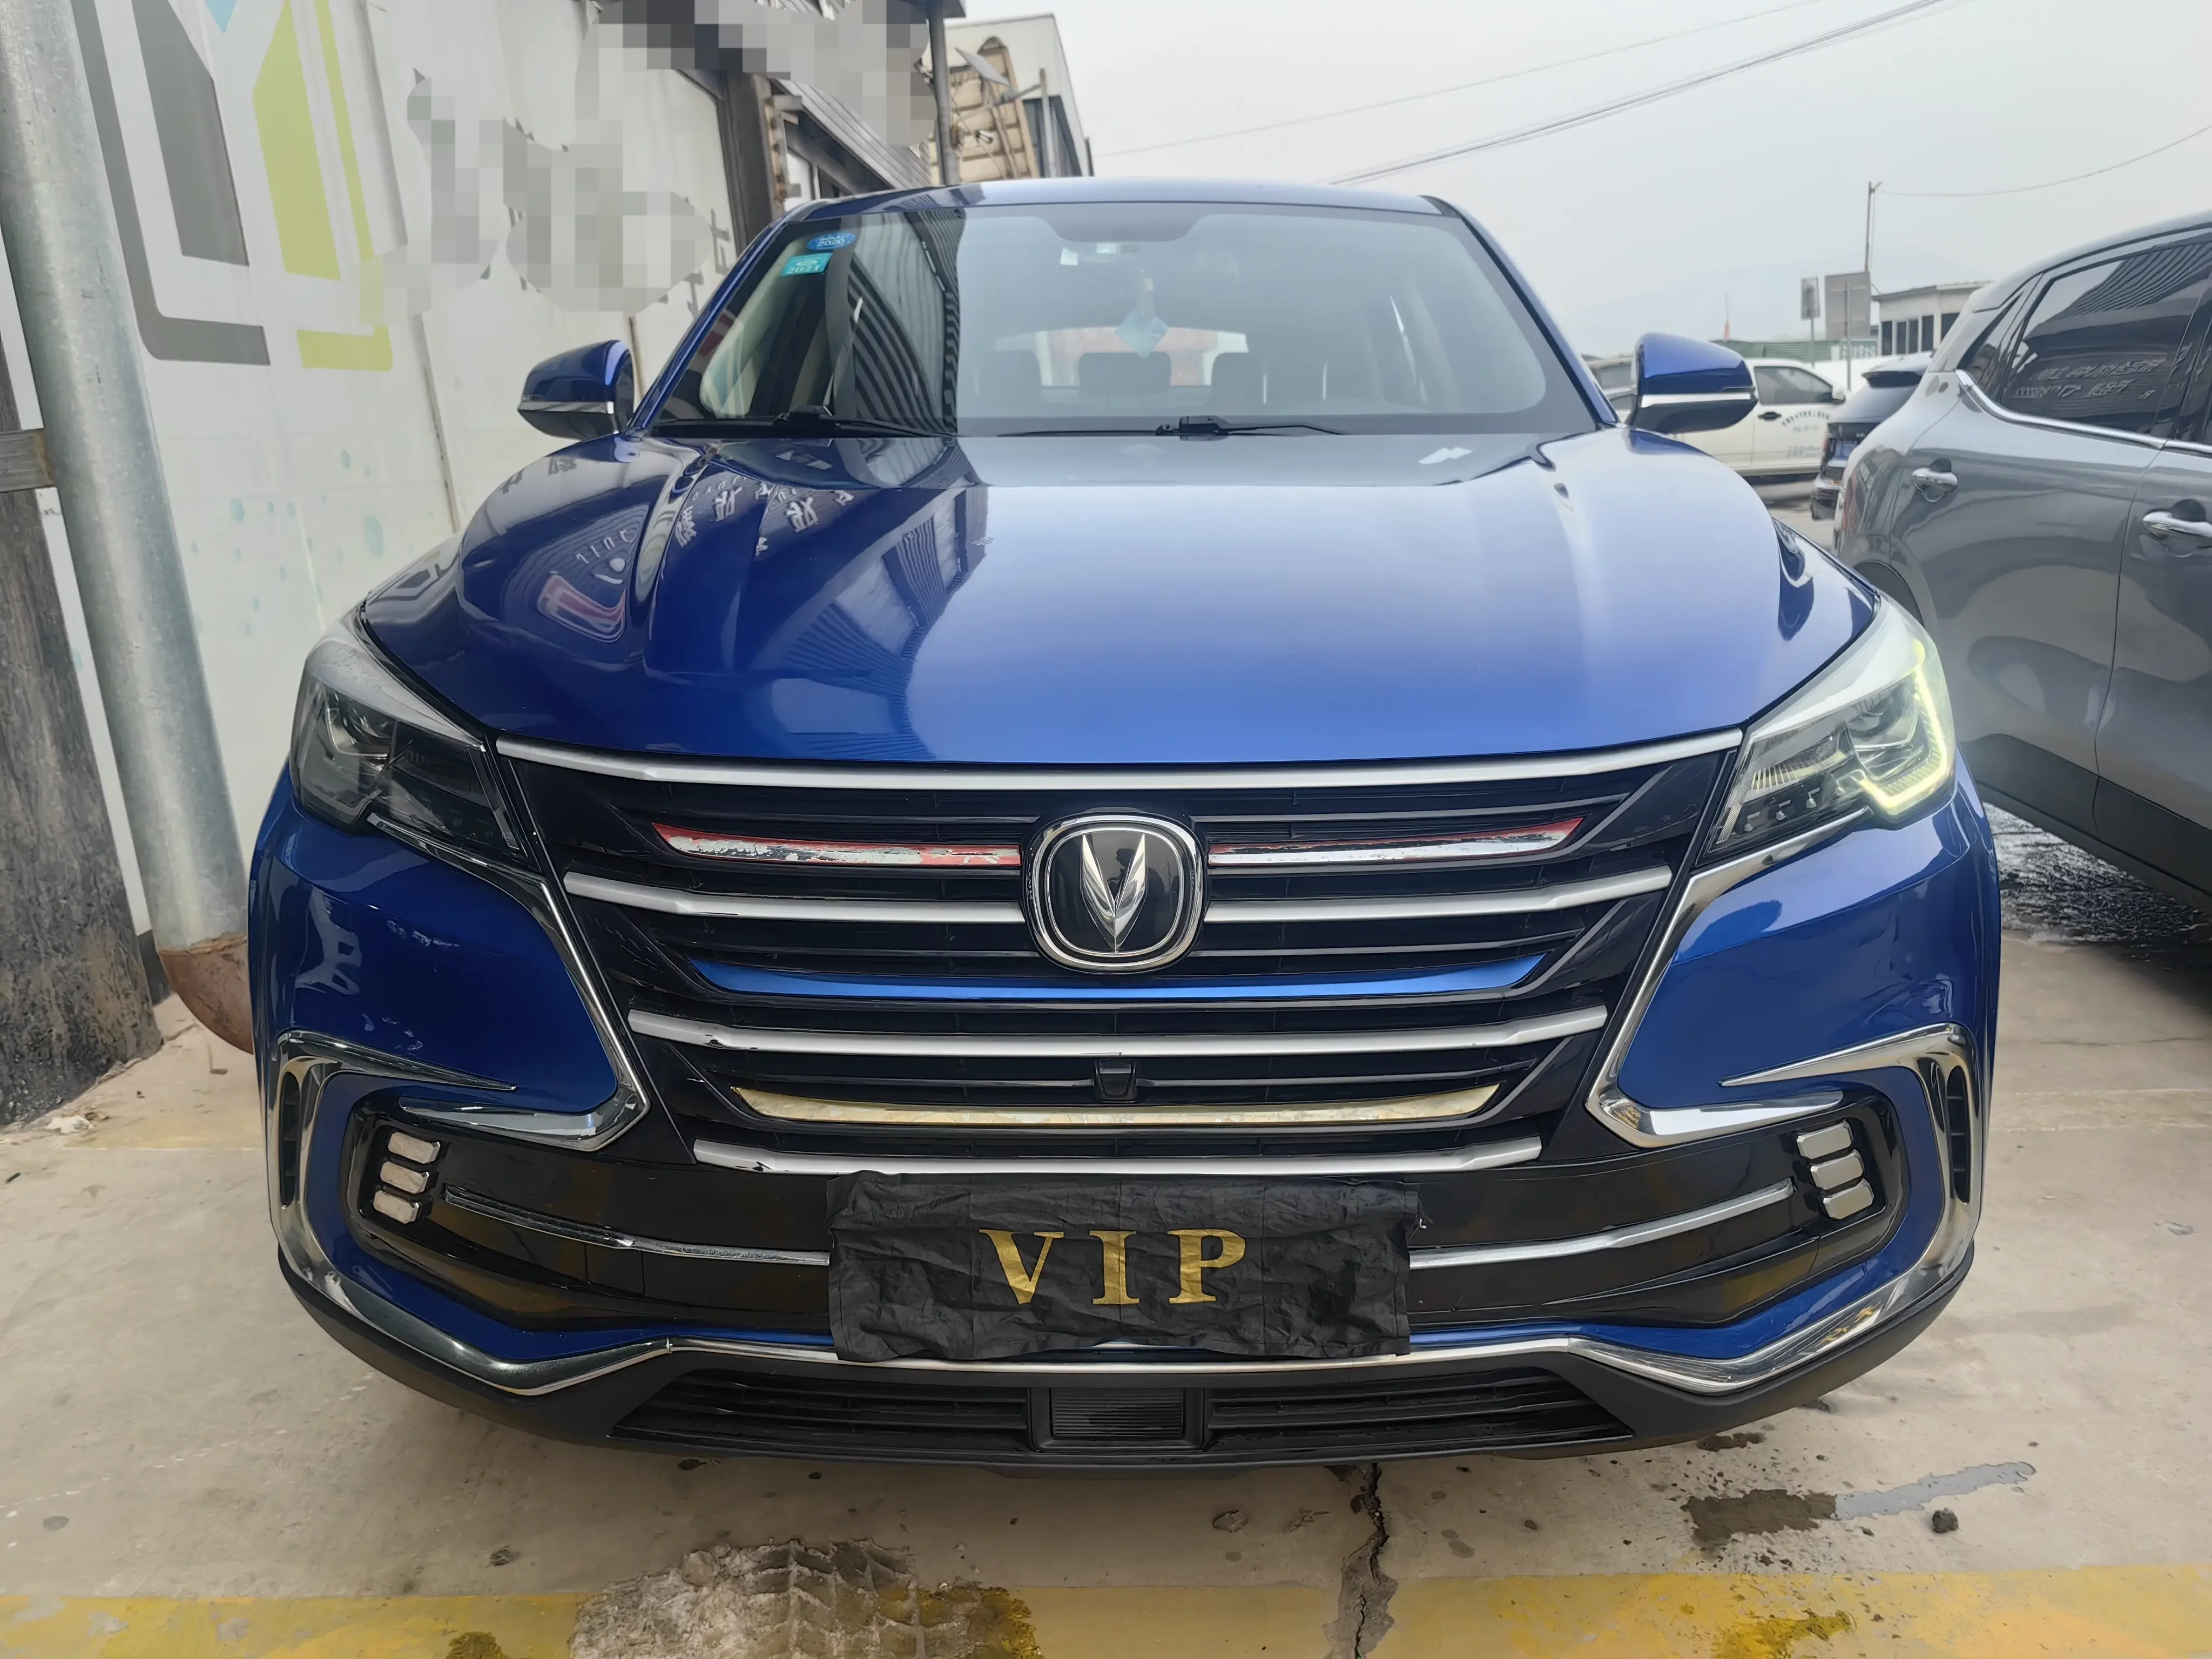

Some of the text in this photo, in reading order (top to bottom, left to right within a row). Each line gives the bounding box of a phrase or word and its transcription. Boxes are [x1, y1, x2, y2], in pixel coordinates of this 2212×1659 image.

[818, 239, 845, 247] 2020
[786, 265, 820, 274] 2021
[979, 1229, 1246, 1305] VIP
